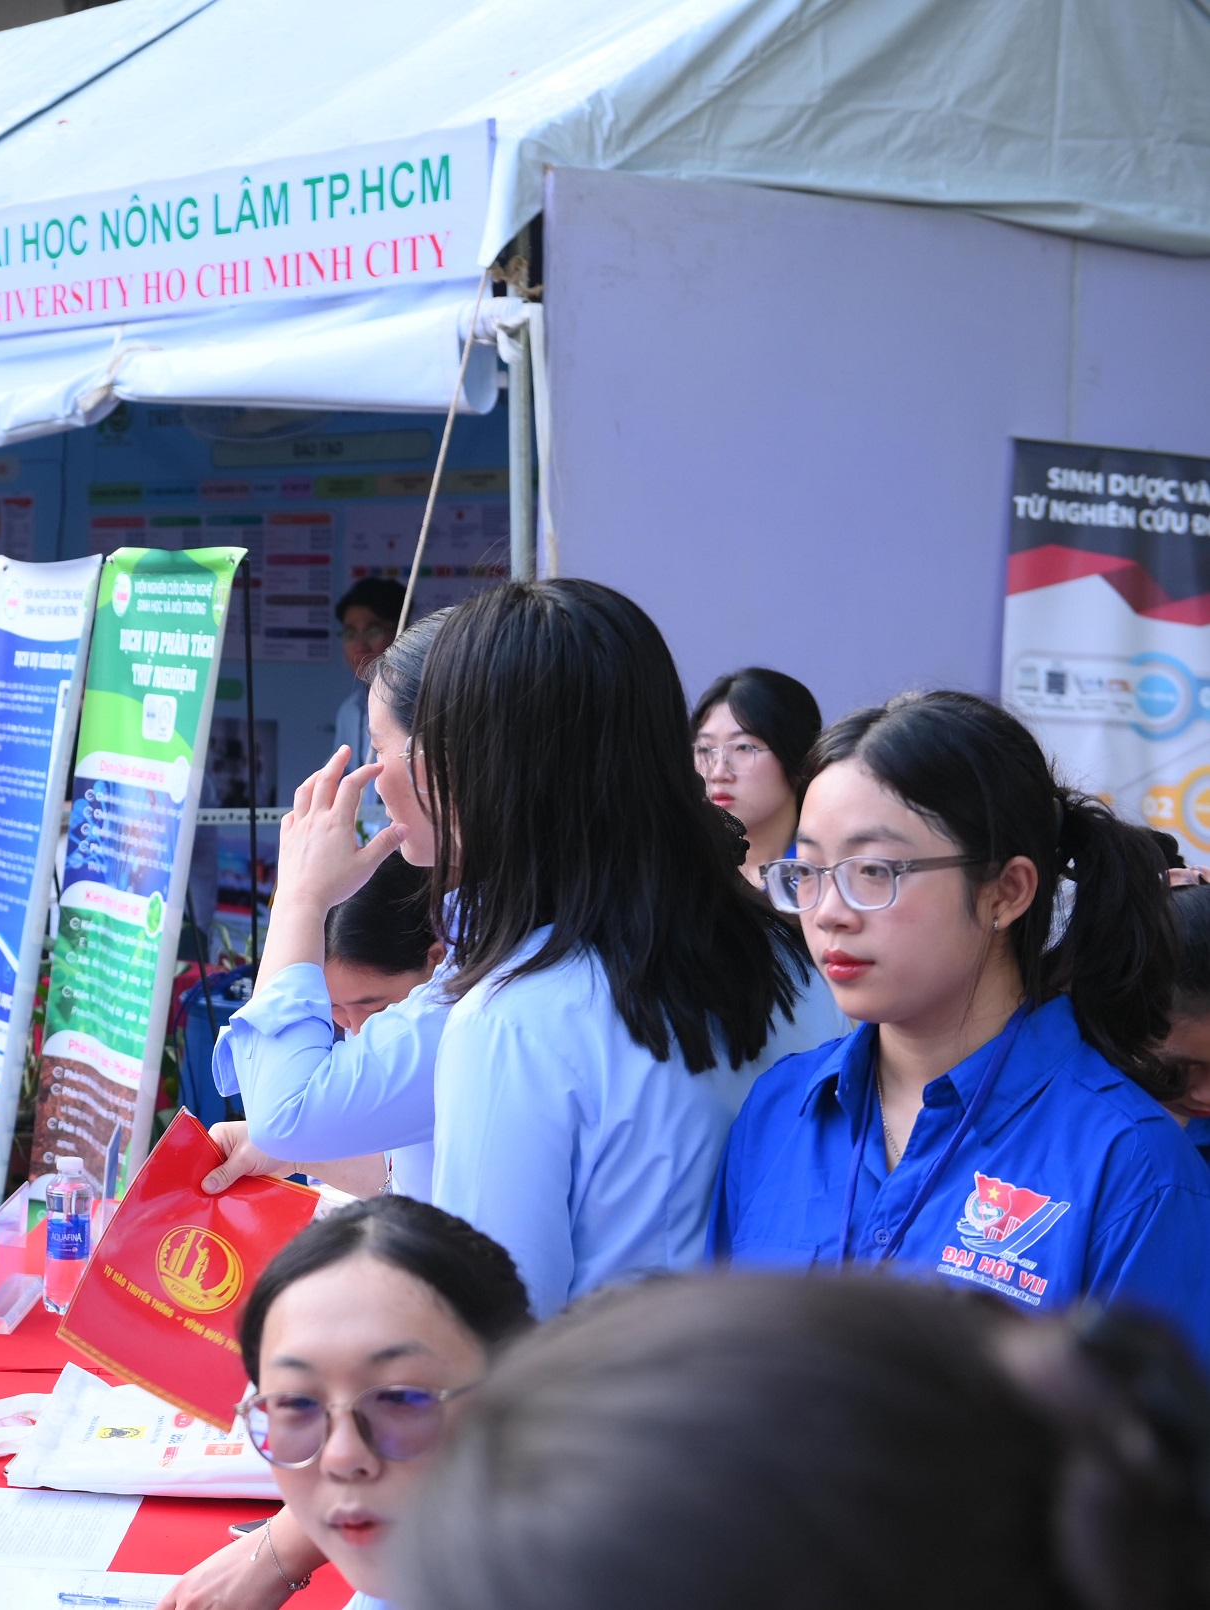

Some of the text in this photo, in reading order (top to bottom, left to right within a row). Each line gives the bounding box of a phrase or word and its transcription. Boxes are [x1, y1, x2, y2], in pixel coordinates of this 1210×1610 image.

[21, 215, 88, 270] HỌC
[100, 194, 199, 252] NÔNG
[213, 176, 289, 236] LÂM
[303, 154, 452, 218] TP.HCM
[144, 267, 186, 303] HO
[195, 259, 252, 299] CHI
[262, 243, 353, 291] MINH
[363, 231, 453, 278] CITY
[1047, 467, 1104, 495] SINH
[1108, 473, 1180, 506] DƯỢC
[1013, 492, 1048, 520] TỪ
[1049, 500, 1137, 529] NGHIÊN
[1138, 506, 1188, 535] CỨU
[119, 628, 143, 654] DỊCH
[51, 1232, 82, 1242] AQUAFINA
[103, 1264, 114, 1279] TỰ
[112, 1272, 127, 1288] HÀO
[942, 1246, 1048, 1295] ĐẠI HỘI VII
